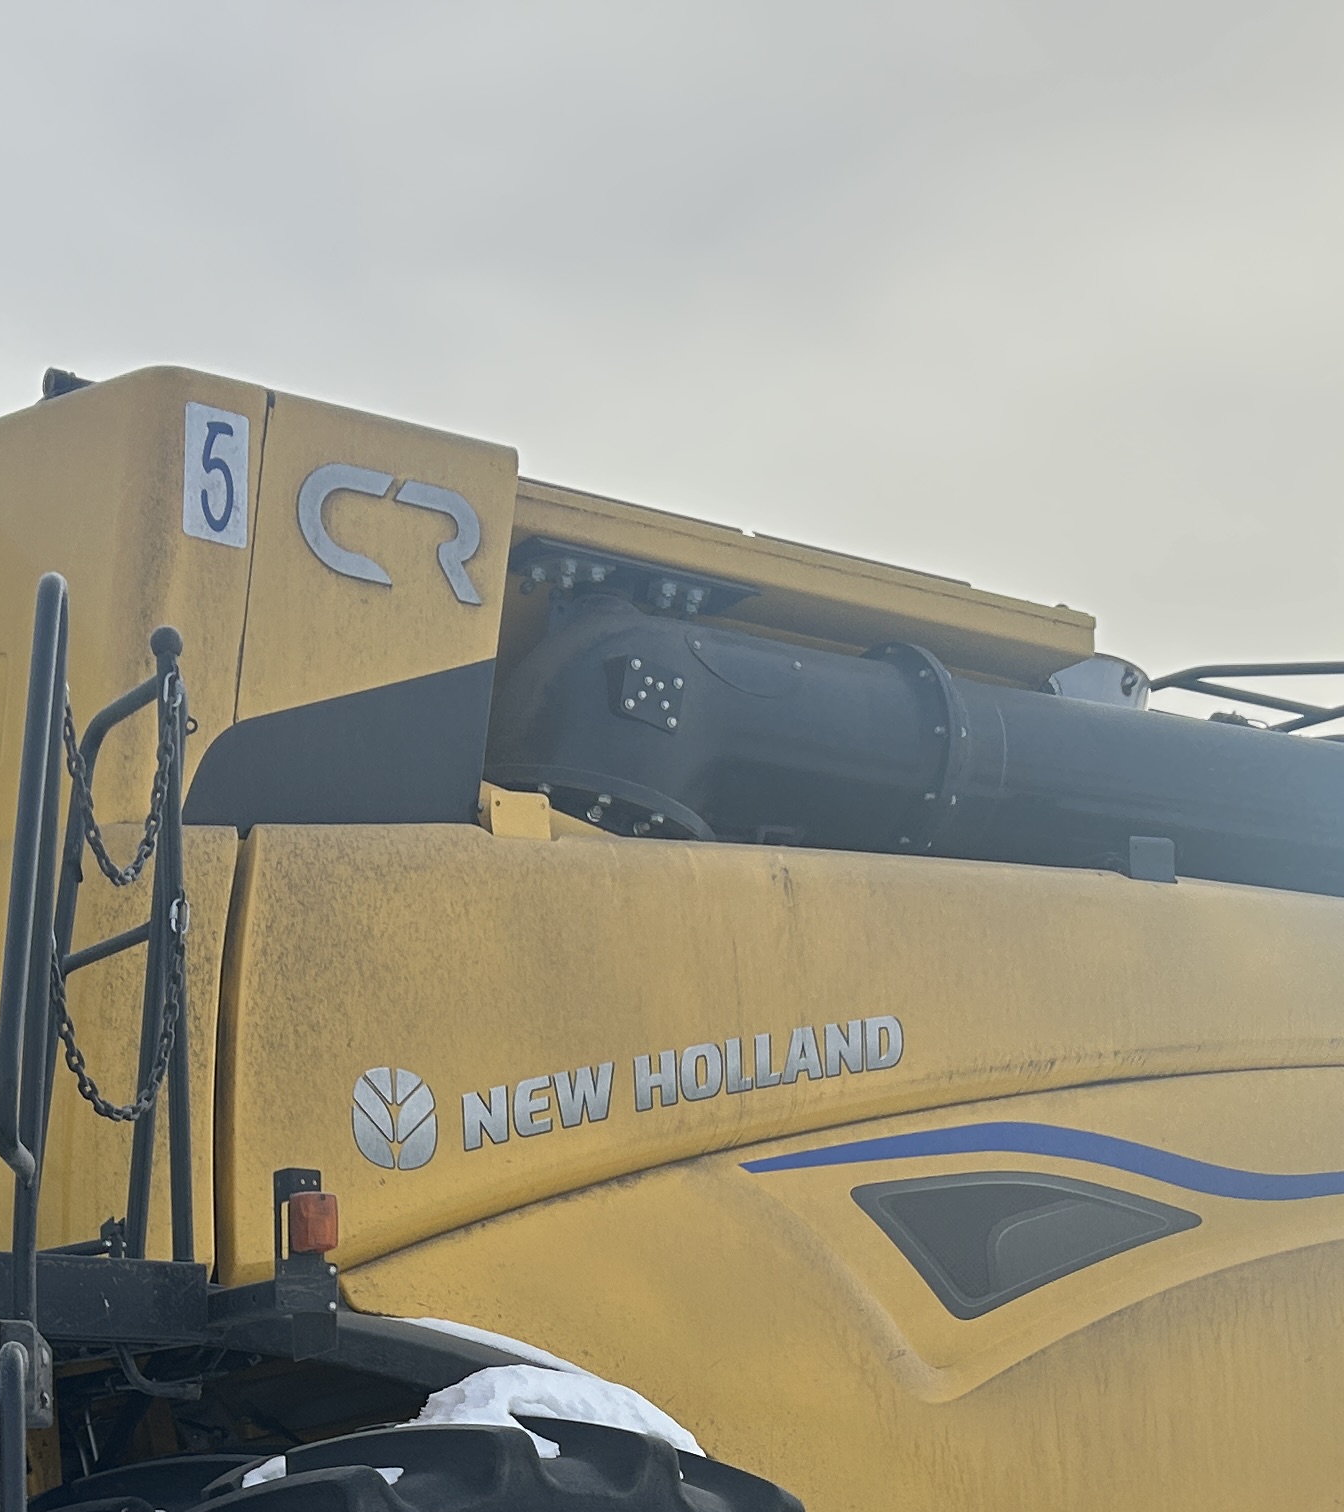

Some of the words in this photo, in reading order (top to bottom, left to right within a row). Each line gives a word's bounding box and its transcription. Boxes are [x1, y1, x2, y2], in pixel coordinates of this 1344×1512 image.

[200, 421, 234, 532] 5
[296, 461, 483, 606] CR
[461, 1061, 614, 1151] NEW
[633, 1014, 904, 1112] HOLLAND
